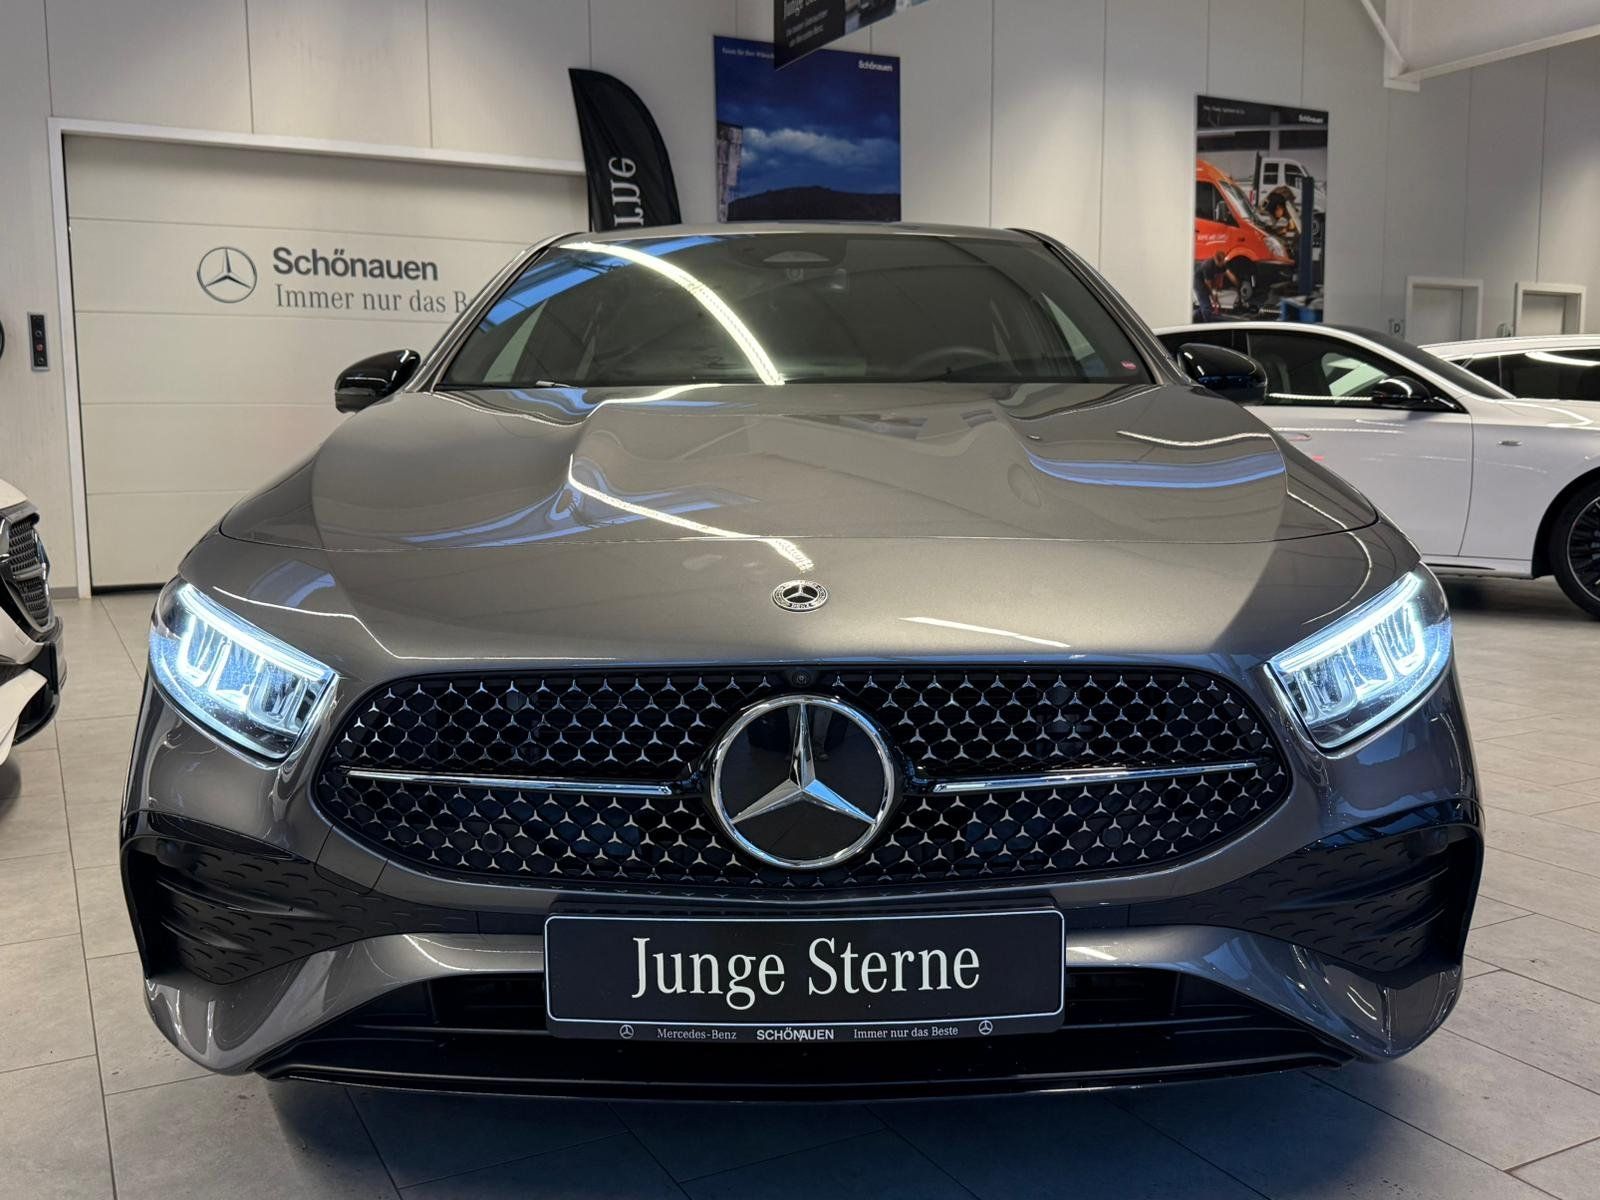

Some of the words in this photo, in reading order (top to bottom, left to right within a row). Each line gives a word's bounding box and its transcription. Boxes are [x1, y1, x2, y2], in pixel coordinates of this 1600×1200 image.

[273, 247, 438, 281] Schönauen
[276, 284, 354, 310] Immer
[363, 291, 402, 311] nur
[409, 290, 447, 313] das
[632, 937, 785, 1010] Junge
[808, 937, 980, 996] Sterne
[656, 1028, 737, 1040] Mercedes-Benz
[756, 1026, 835, 1042] SCHÖNAUEN
[853, 1029, 888, 1039] Immer
[890, 1029, 909, 1038] nur
[911, 1026, 929, 1037] das
[931, 1025, 959, 1037] Beste
